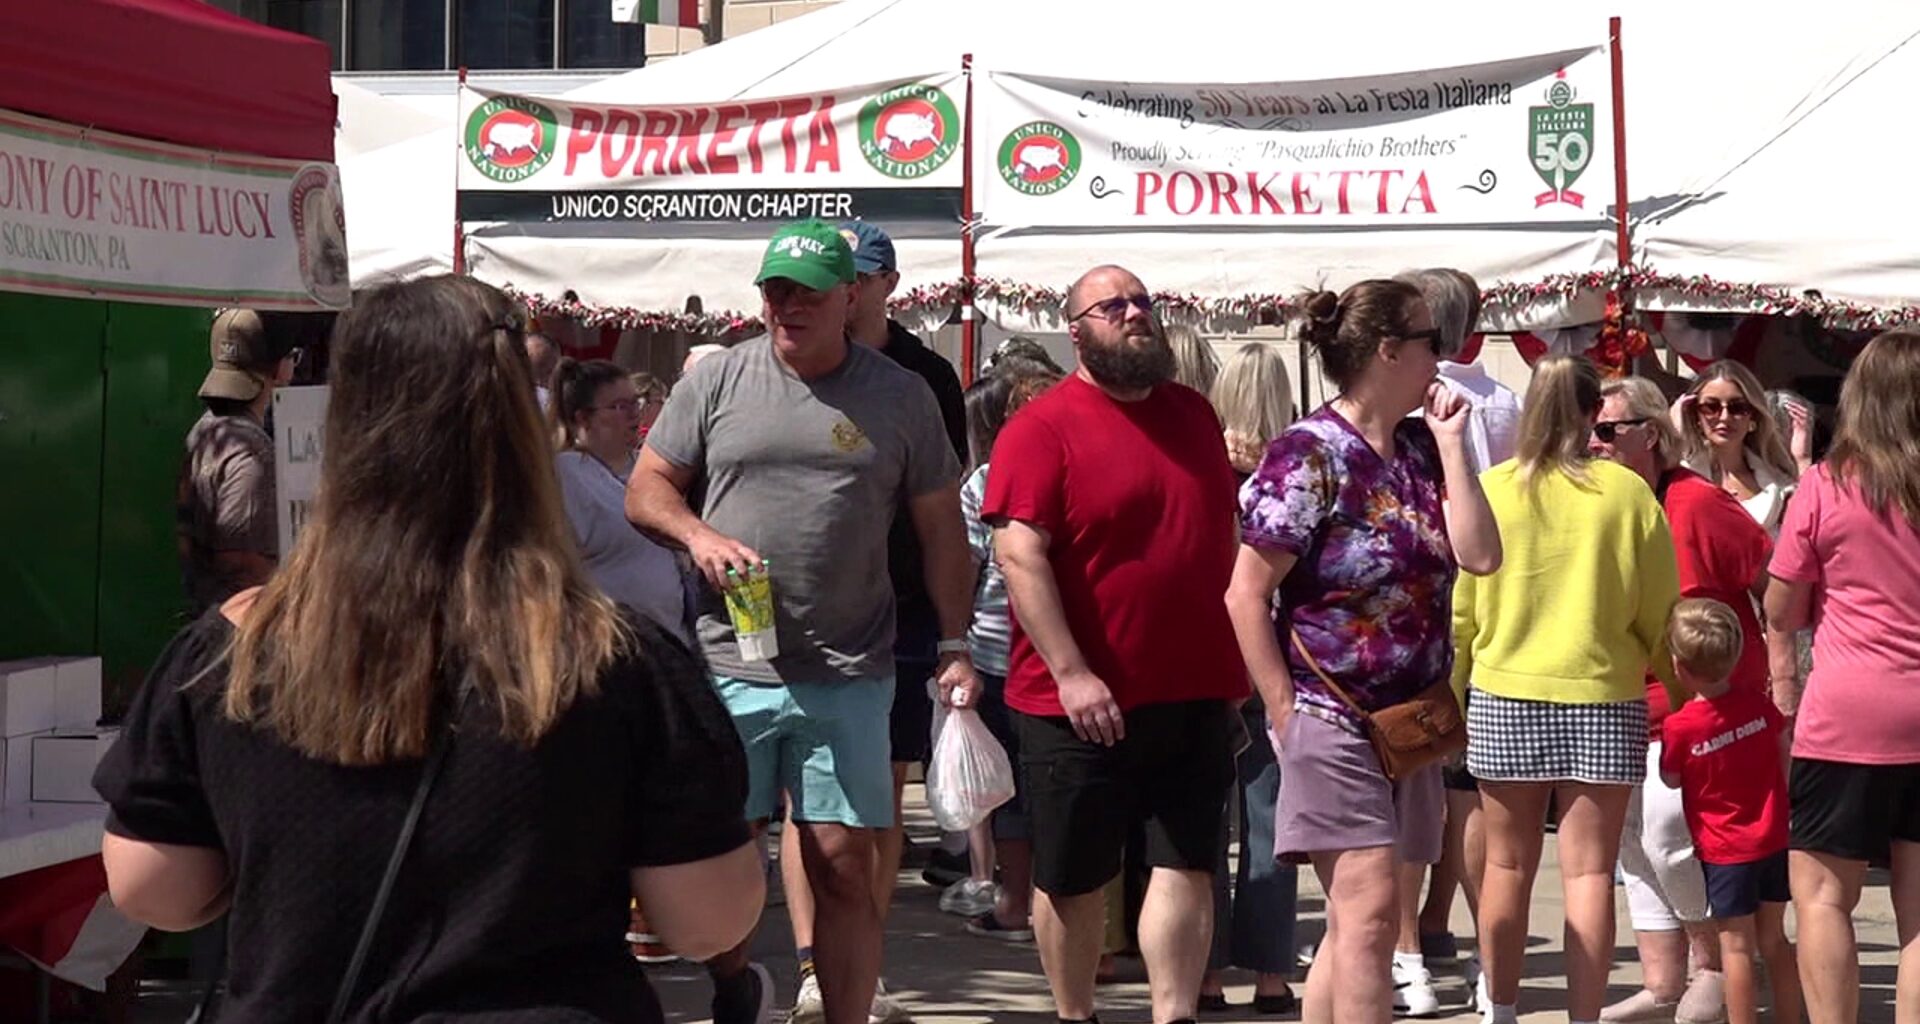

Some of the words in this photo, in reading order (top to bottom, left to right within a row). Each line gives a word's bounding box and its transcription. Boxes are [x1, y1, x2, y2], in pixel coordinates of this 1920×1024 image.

[483, 97, 541, 116] UNICO
[877, 84, 940, 106] UNICO
[1196, 89, 1232, 117] 50
[1230, 88, 1310, 117] Years
[1313, 95, 1337, 115] at
[1336, 92, 1369, 113] La
[1369, 86, 1430, 112] Festa
[1433, 77, 1512, 109] Italiana
[563, 95, 841, 178] PORKETTA
[1013, 123, 1064, 141] UNICO
[467, 145, 552, 181] NATIONAL
[861, 140, 955, 178] NATIONAL
[1111, 141, 1168, 168] Proudly
[1535, 132, 1589, 171] 50
[1001, 165, 1078, 195] NATIONAL
[1133, 170, 1438, 216] PORKETTA
[63, 163, 103, 221] OF
[109, 171, 190, 233] SAINT
[195, 184, 276, 239] LUCY
[551, 195, 619, 218] UNICO
[622, 194, 742, 218] SCRANTON
[746, 193, 852, 218] CHAPTER
[2, 220, 105, 272] SCRANTON,
[108, 235, 131, 271] PA
